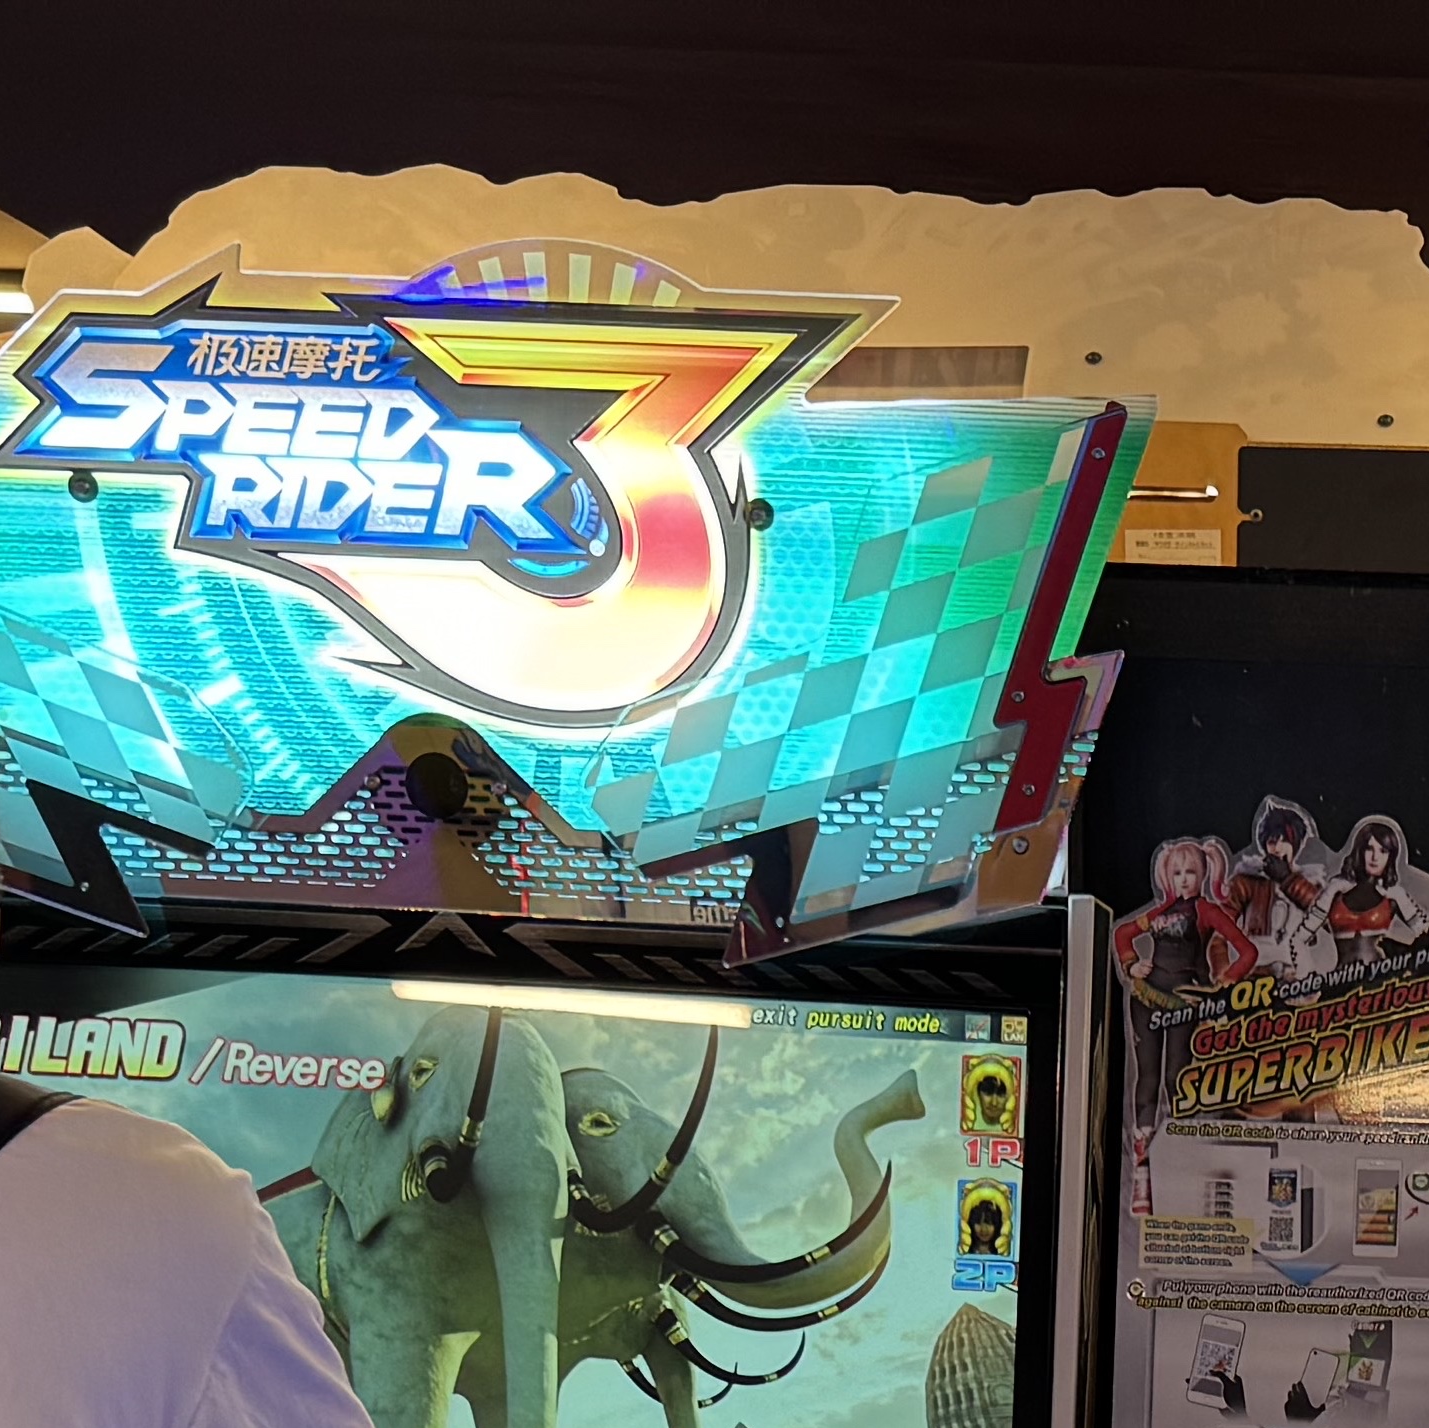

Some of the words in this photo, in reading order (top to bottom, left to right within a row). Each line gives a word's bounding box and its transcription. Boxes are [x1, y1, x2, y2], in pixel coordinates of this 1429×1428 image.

[186, 336, 380, 382] 极速摩托
[40, 344, 440, 460] SPEED
[206, 430, 558, 541] RIDER
[1149, 1008, 1193, 1031] Scan
[1198, 998, 1226, 1018] the
[1230, 976, 1275, 1011] QR
[1278, 976, 1322, 999] code
[1324, 965, 1366, 989] with
[1368, 955, 1410, 981] your
[752, 1005, 798, 1026] exit
[807, 1009, 885, 1030] pursuit
[1004, 1033, 1024, 1042] LAN
[1194, 1023, 1242, 1056] Get
[1246, 1013, 1289, 1042] the
[1167, 1123, 1197, 1136] Scan
[1199, 1125, 1220, 1137] the
[1244, 1126, 1274, 1138] code
[952, 1260, 1015, 1291] 2P
[1137, 1297, 1183, 1309] against
[1187, 1297, 1208, 1309] the
[1209, 1299, 1254, 1311] camera
[1256, 1300, 1273, 1312] on
[1275, 1300, 1295, 1312] the
[1297, 1303, 1340, 1315] screen
[1341, 1303, 1355, 1316] of
[1185, 1283, 1215, 1294] your
[1216, 1283, 1255, 1296] phone
[1257, 1283, 1283, 1296] with
[1285, 1285, 1306, 1297] the
[1386, 1289, 1405, 1301] QR
